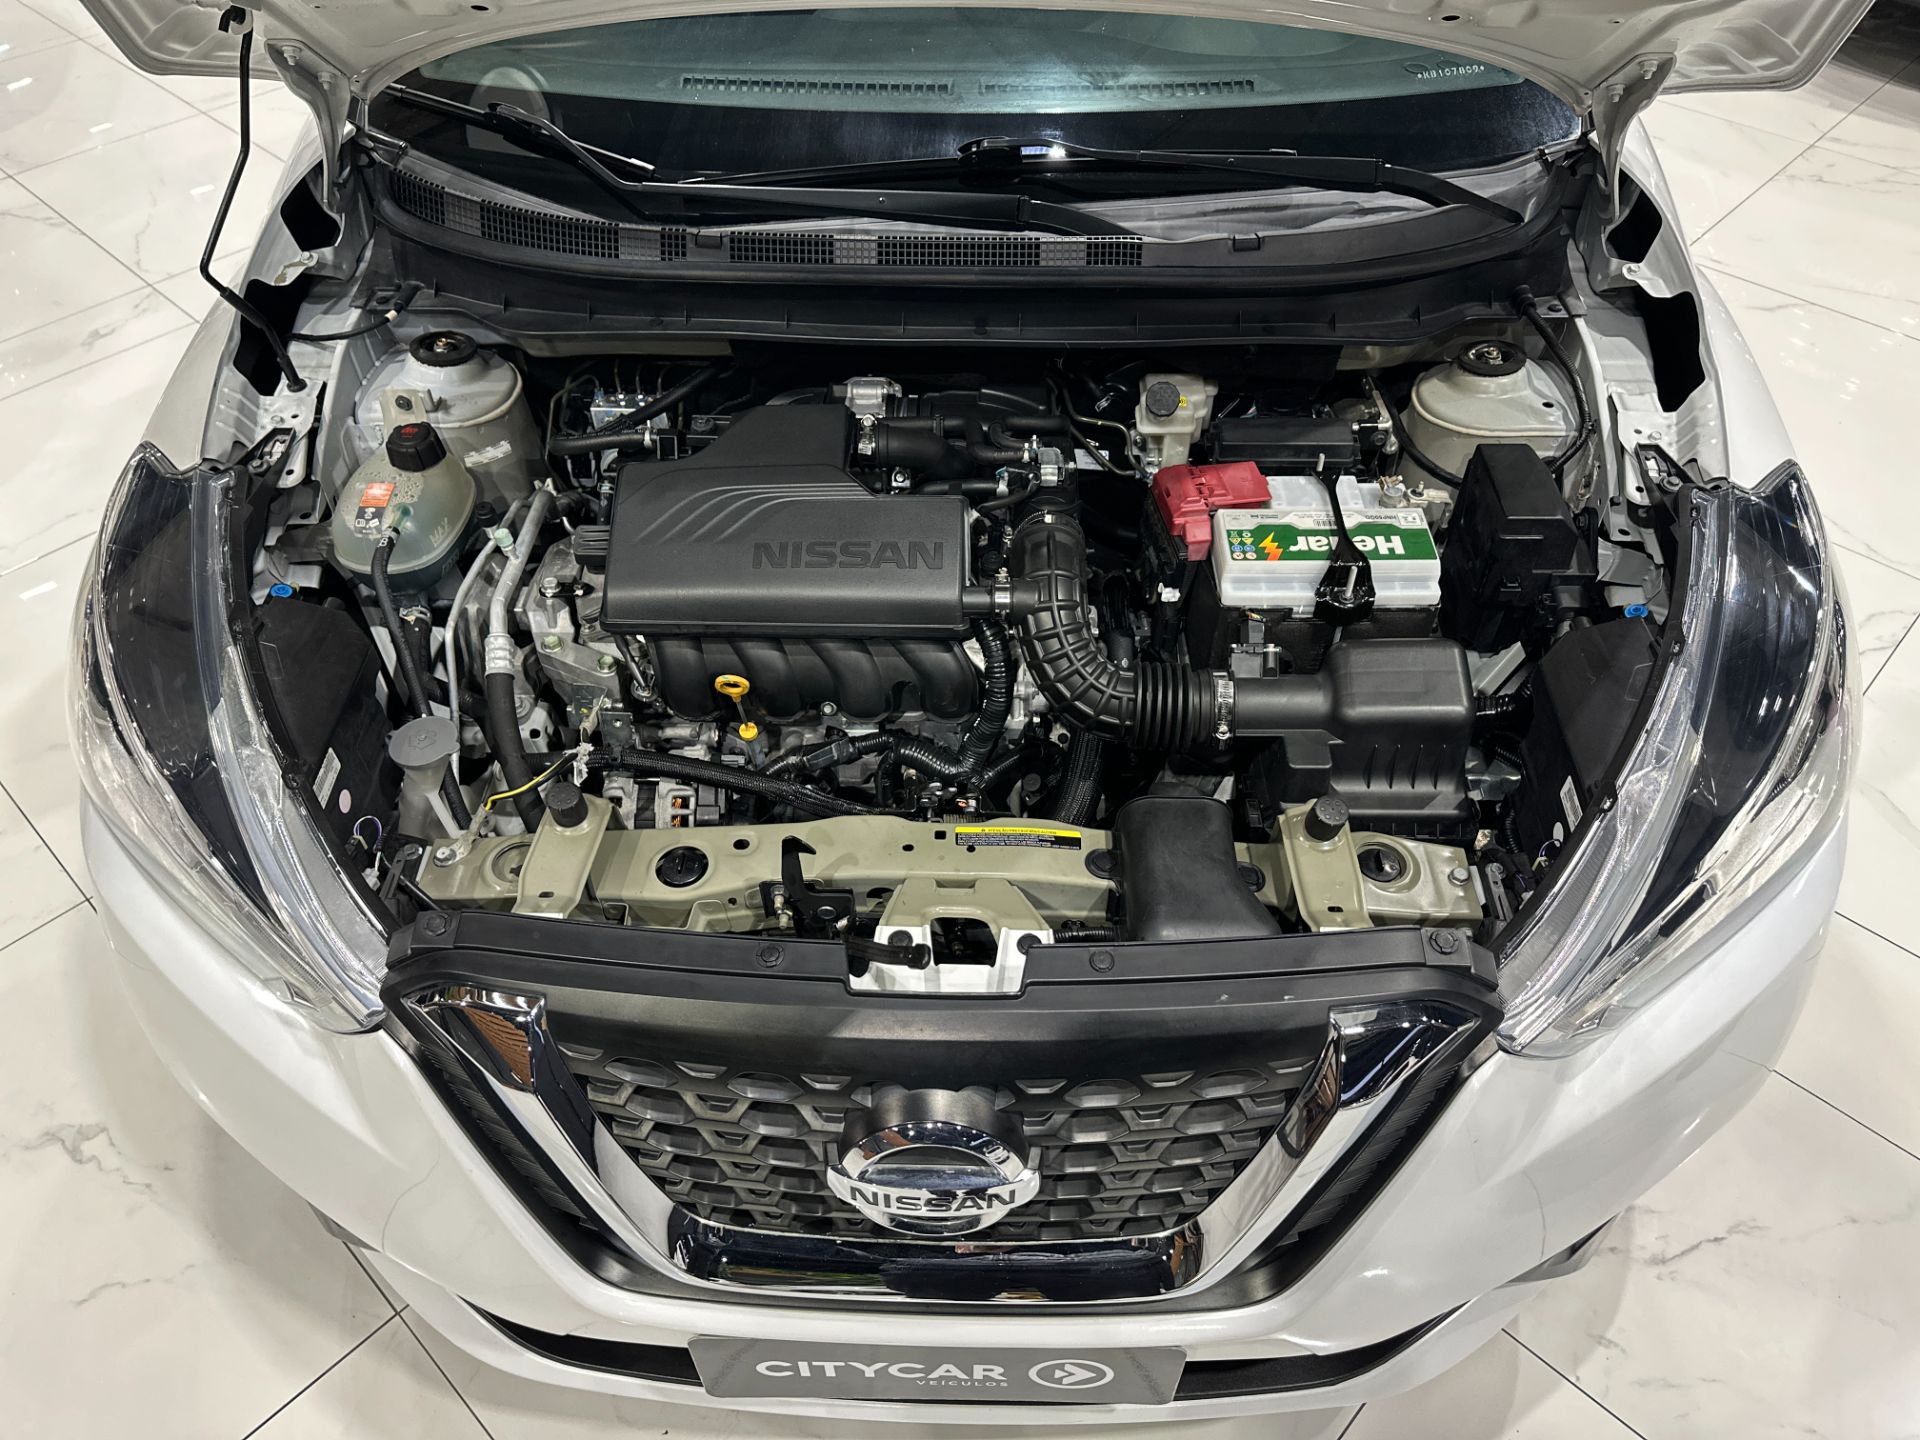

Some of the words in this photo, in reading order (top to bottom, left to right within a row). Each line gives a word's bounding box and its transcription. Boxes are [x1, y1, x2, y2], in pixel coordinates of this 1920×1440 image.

[752, 541, 944, 570] NISSAN
[1289, 535, 1406, 555] Hear
[850, 1186, 1016, 1212] NISSAN
[756, 1360, 1007, 1380] CITYCAR
